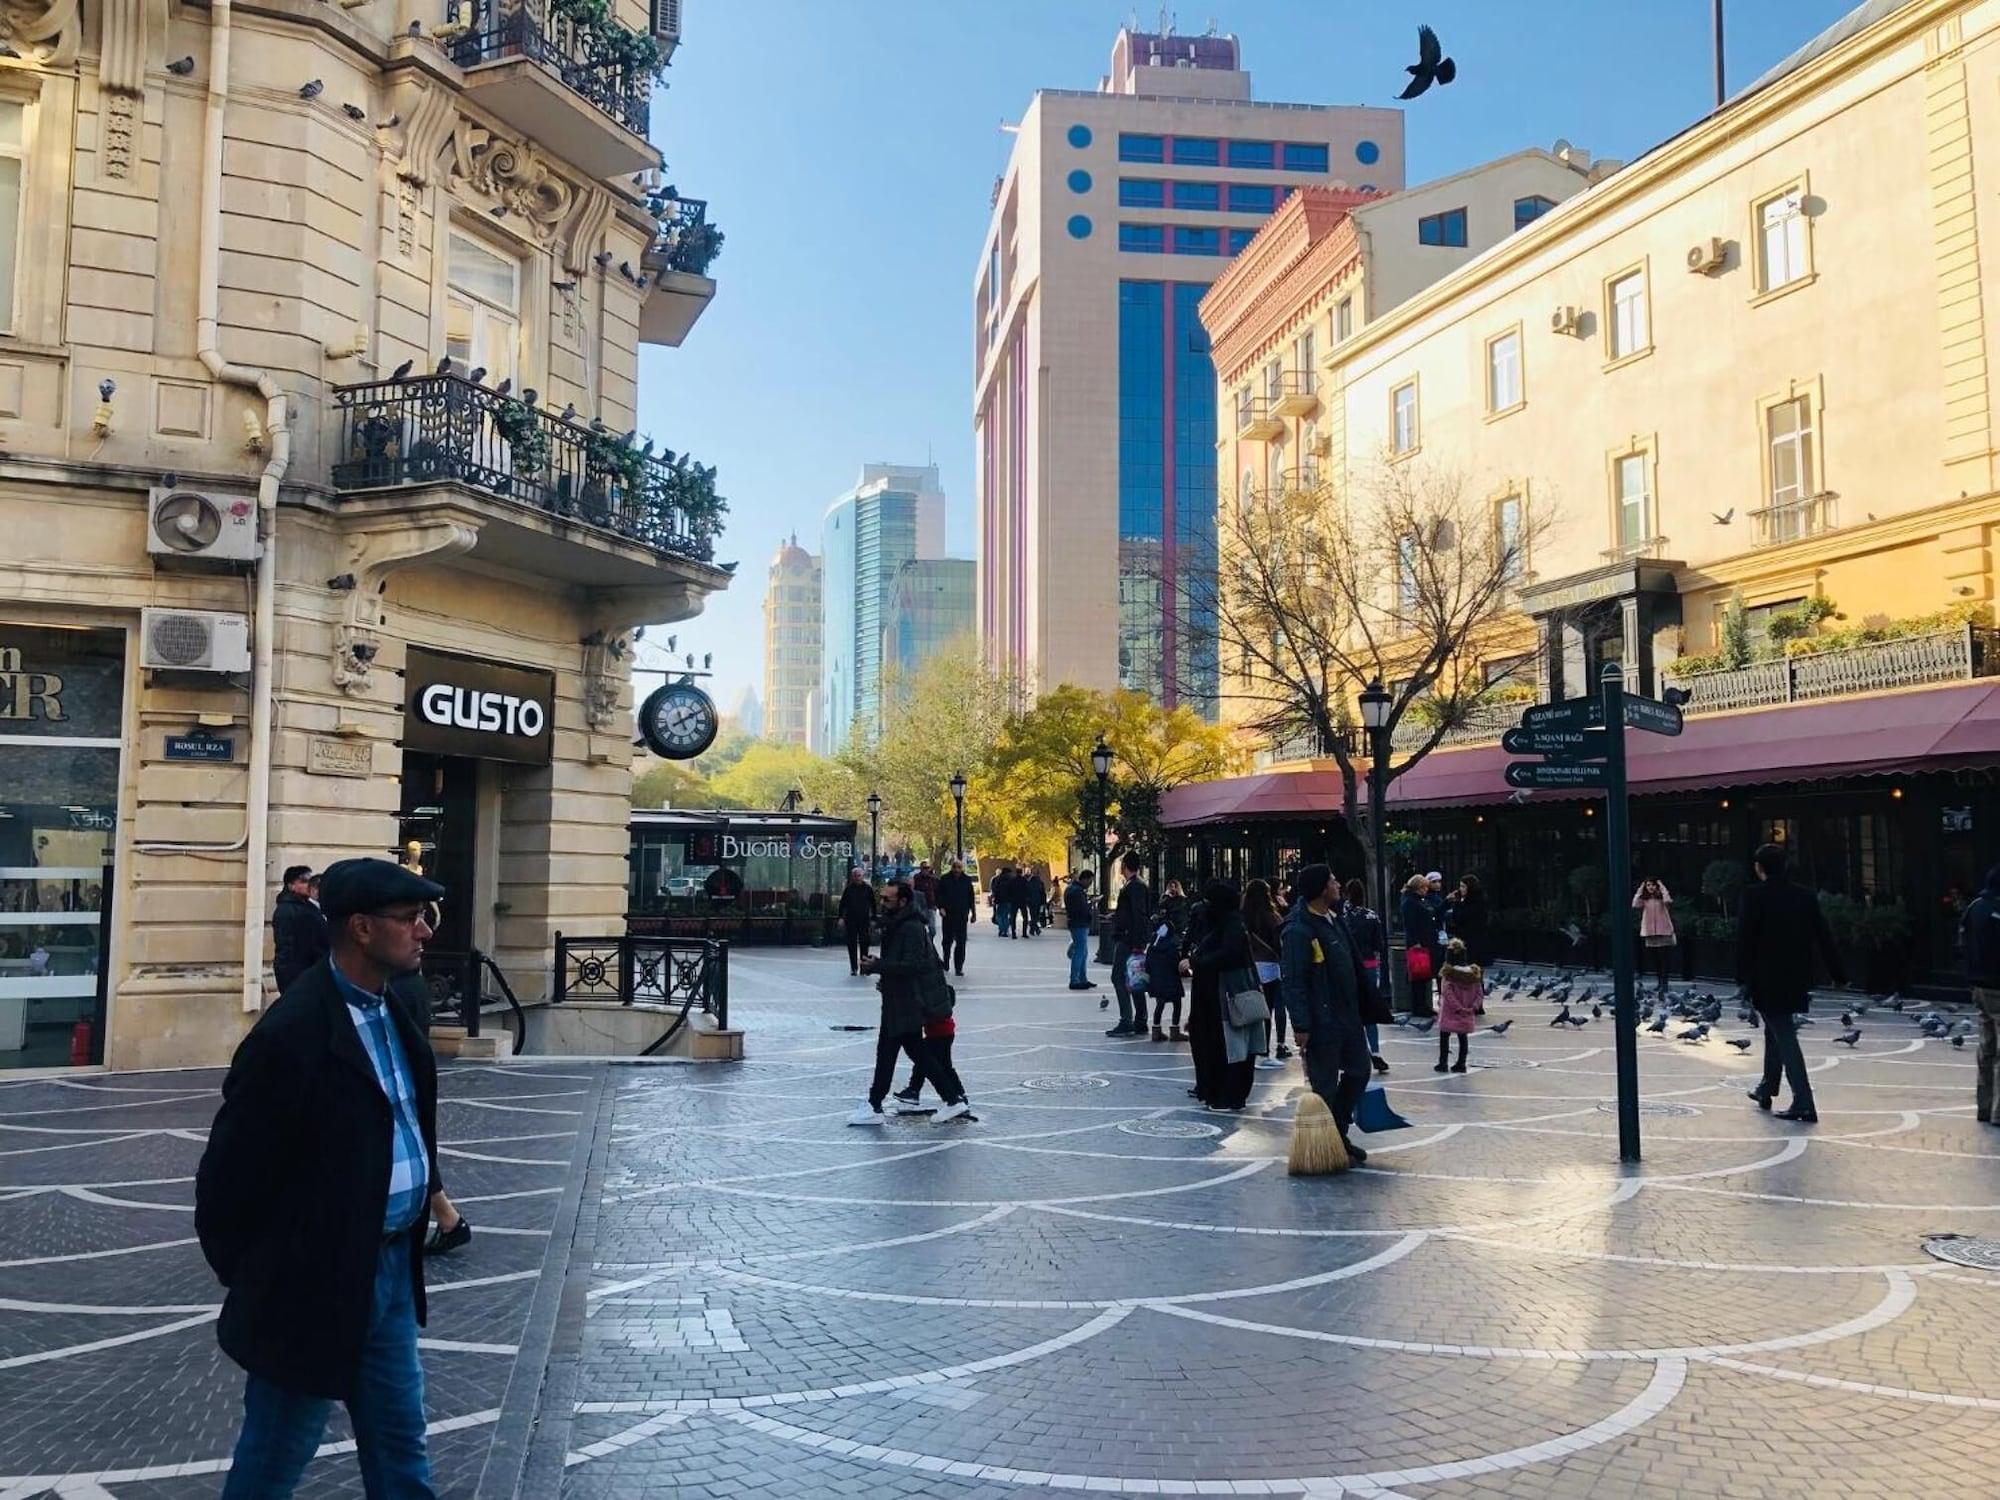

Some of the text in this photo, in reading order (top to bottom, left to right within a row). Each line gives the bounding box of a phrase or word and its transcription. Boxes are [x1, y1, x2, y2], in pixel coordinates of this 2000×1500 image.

[421, 683, 544, 737] GUSTO
[721, 835, 790, 858] Buona
[800, 835, 853, 859] Sera
